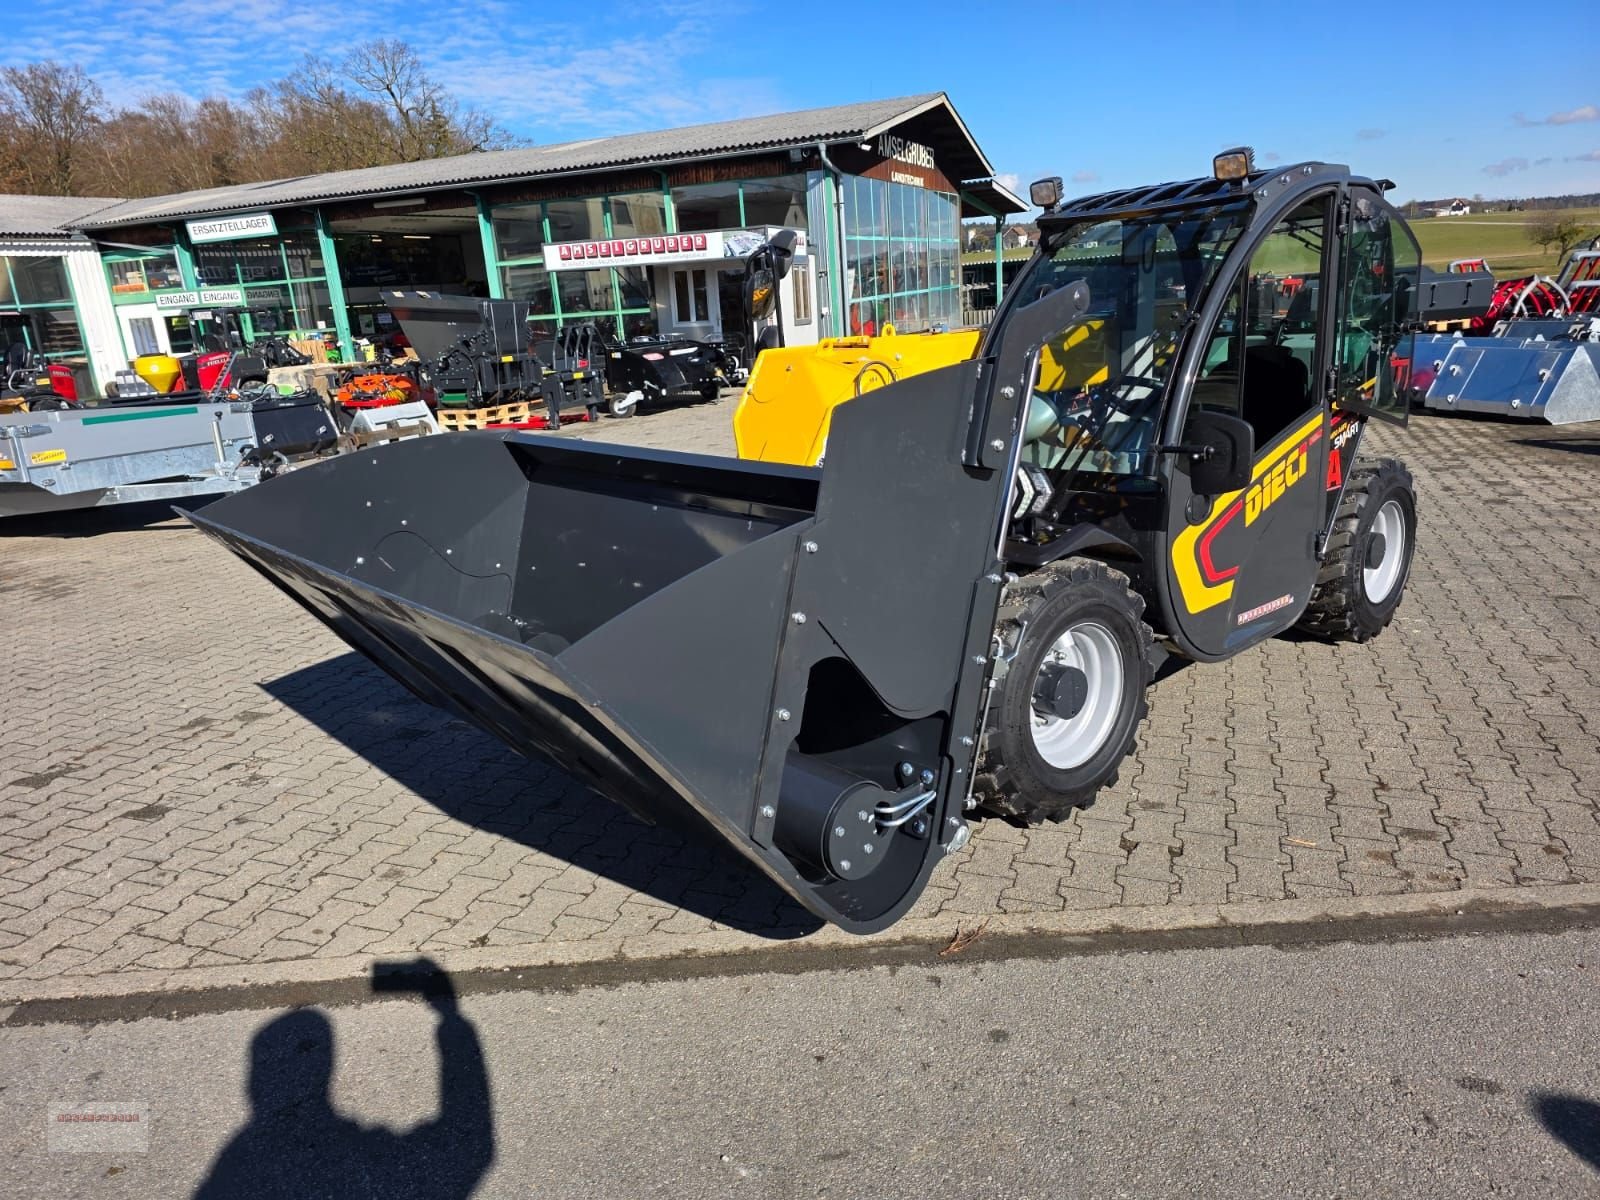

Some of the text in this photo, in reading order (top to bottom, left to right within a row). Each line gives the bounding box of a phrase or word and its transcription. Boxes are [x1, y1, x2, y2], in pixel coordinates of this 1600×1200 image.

[878, 134, 935, 170] AMSELGRUBER
[192, 217, 269, 236] ERSATZTEILLAGER
[559, 236, 706, 258] AMSELGRUBER
[159, 294, 196, 305] EINGANG
[203, 291, 240, 302] EINGANG
[1334, 421, 1359, 450] SMART
[1245, 442, 1308, 528] DIECI
